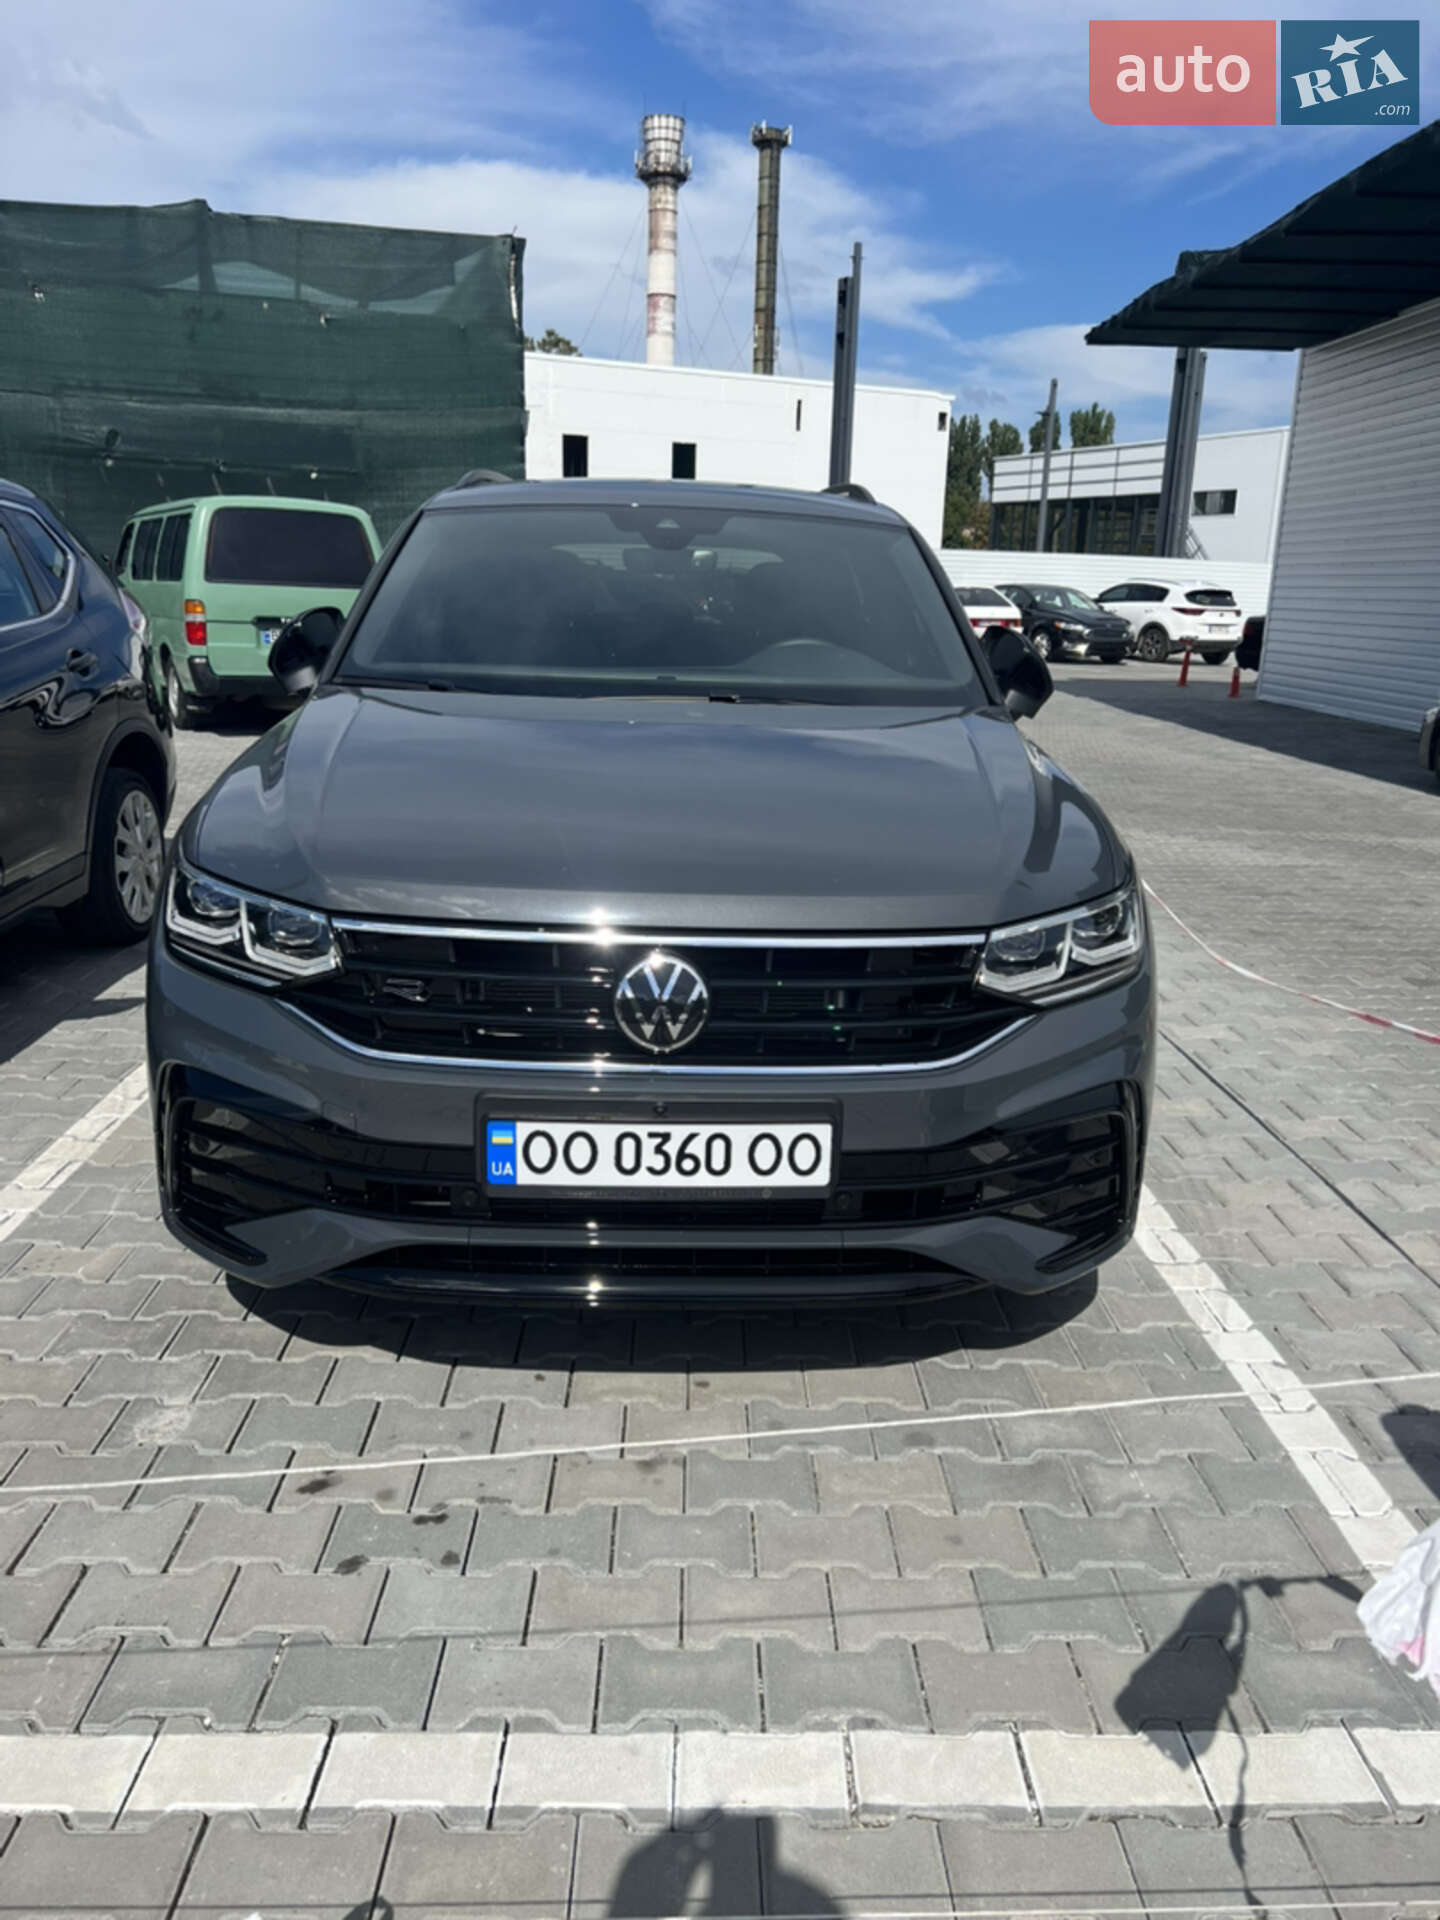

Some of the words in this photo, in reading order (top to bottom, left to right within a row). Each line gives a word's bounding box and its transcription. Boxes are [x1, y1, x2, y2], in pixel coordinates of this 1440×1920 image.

[522, 1130, 598, 1175] OO
[614, 1131, 732, 1177] 0360
[748, 1132, 822, 1177] OO
[491, 1162, 513, 1176] UA
